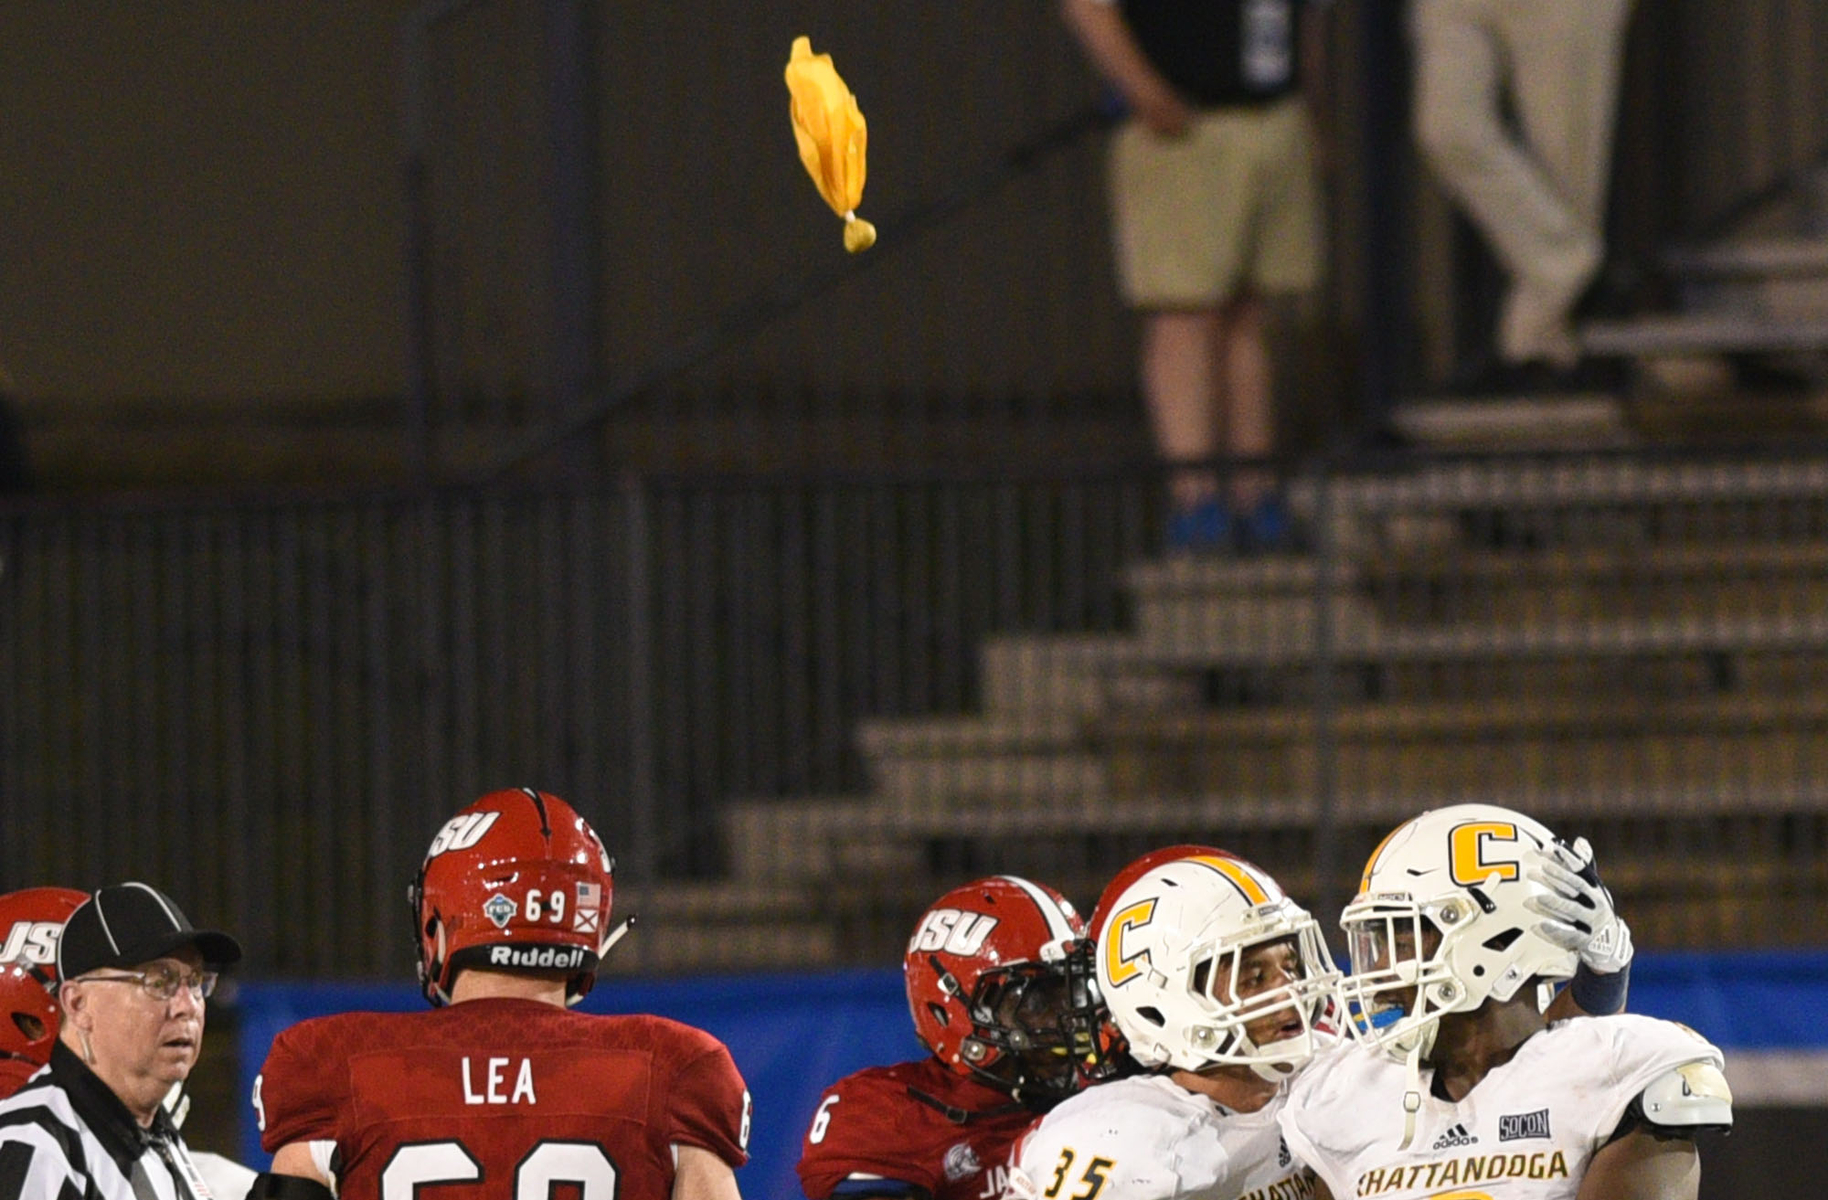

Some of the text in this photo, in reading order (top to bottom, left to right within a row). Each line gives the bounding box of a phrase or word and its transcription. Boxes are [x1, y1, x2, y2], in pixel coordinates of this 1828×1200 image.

[430, 811, 503, 858] SU
[1447, 821, 1519, 888] C
[526, 889, 565, 923] 69
[0, 920, 65, 965] JS
[491, 946, 583, 969] Riddell
[1105, 896, 1160, 988] C
[462, 1057, 536, 1105] LEA
[809, 1093, 830, 1145] 6
[1500, 1109, 1551, 1142] SOCON
[1432, 1136, 1479, 1150] adidas
